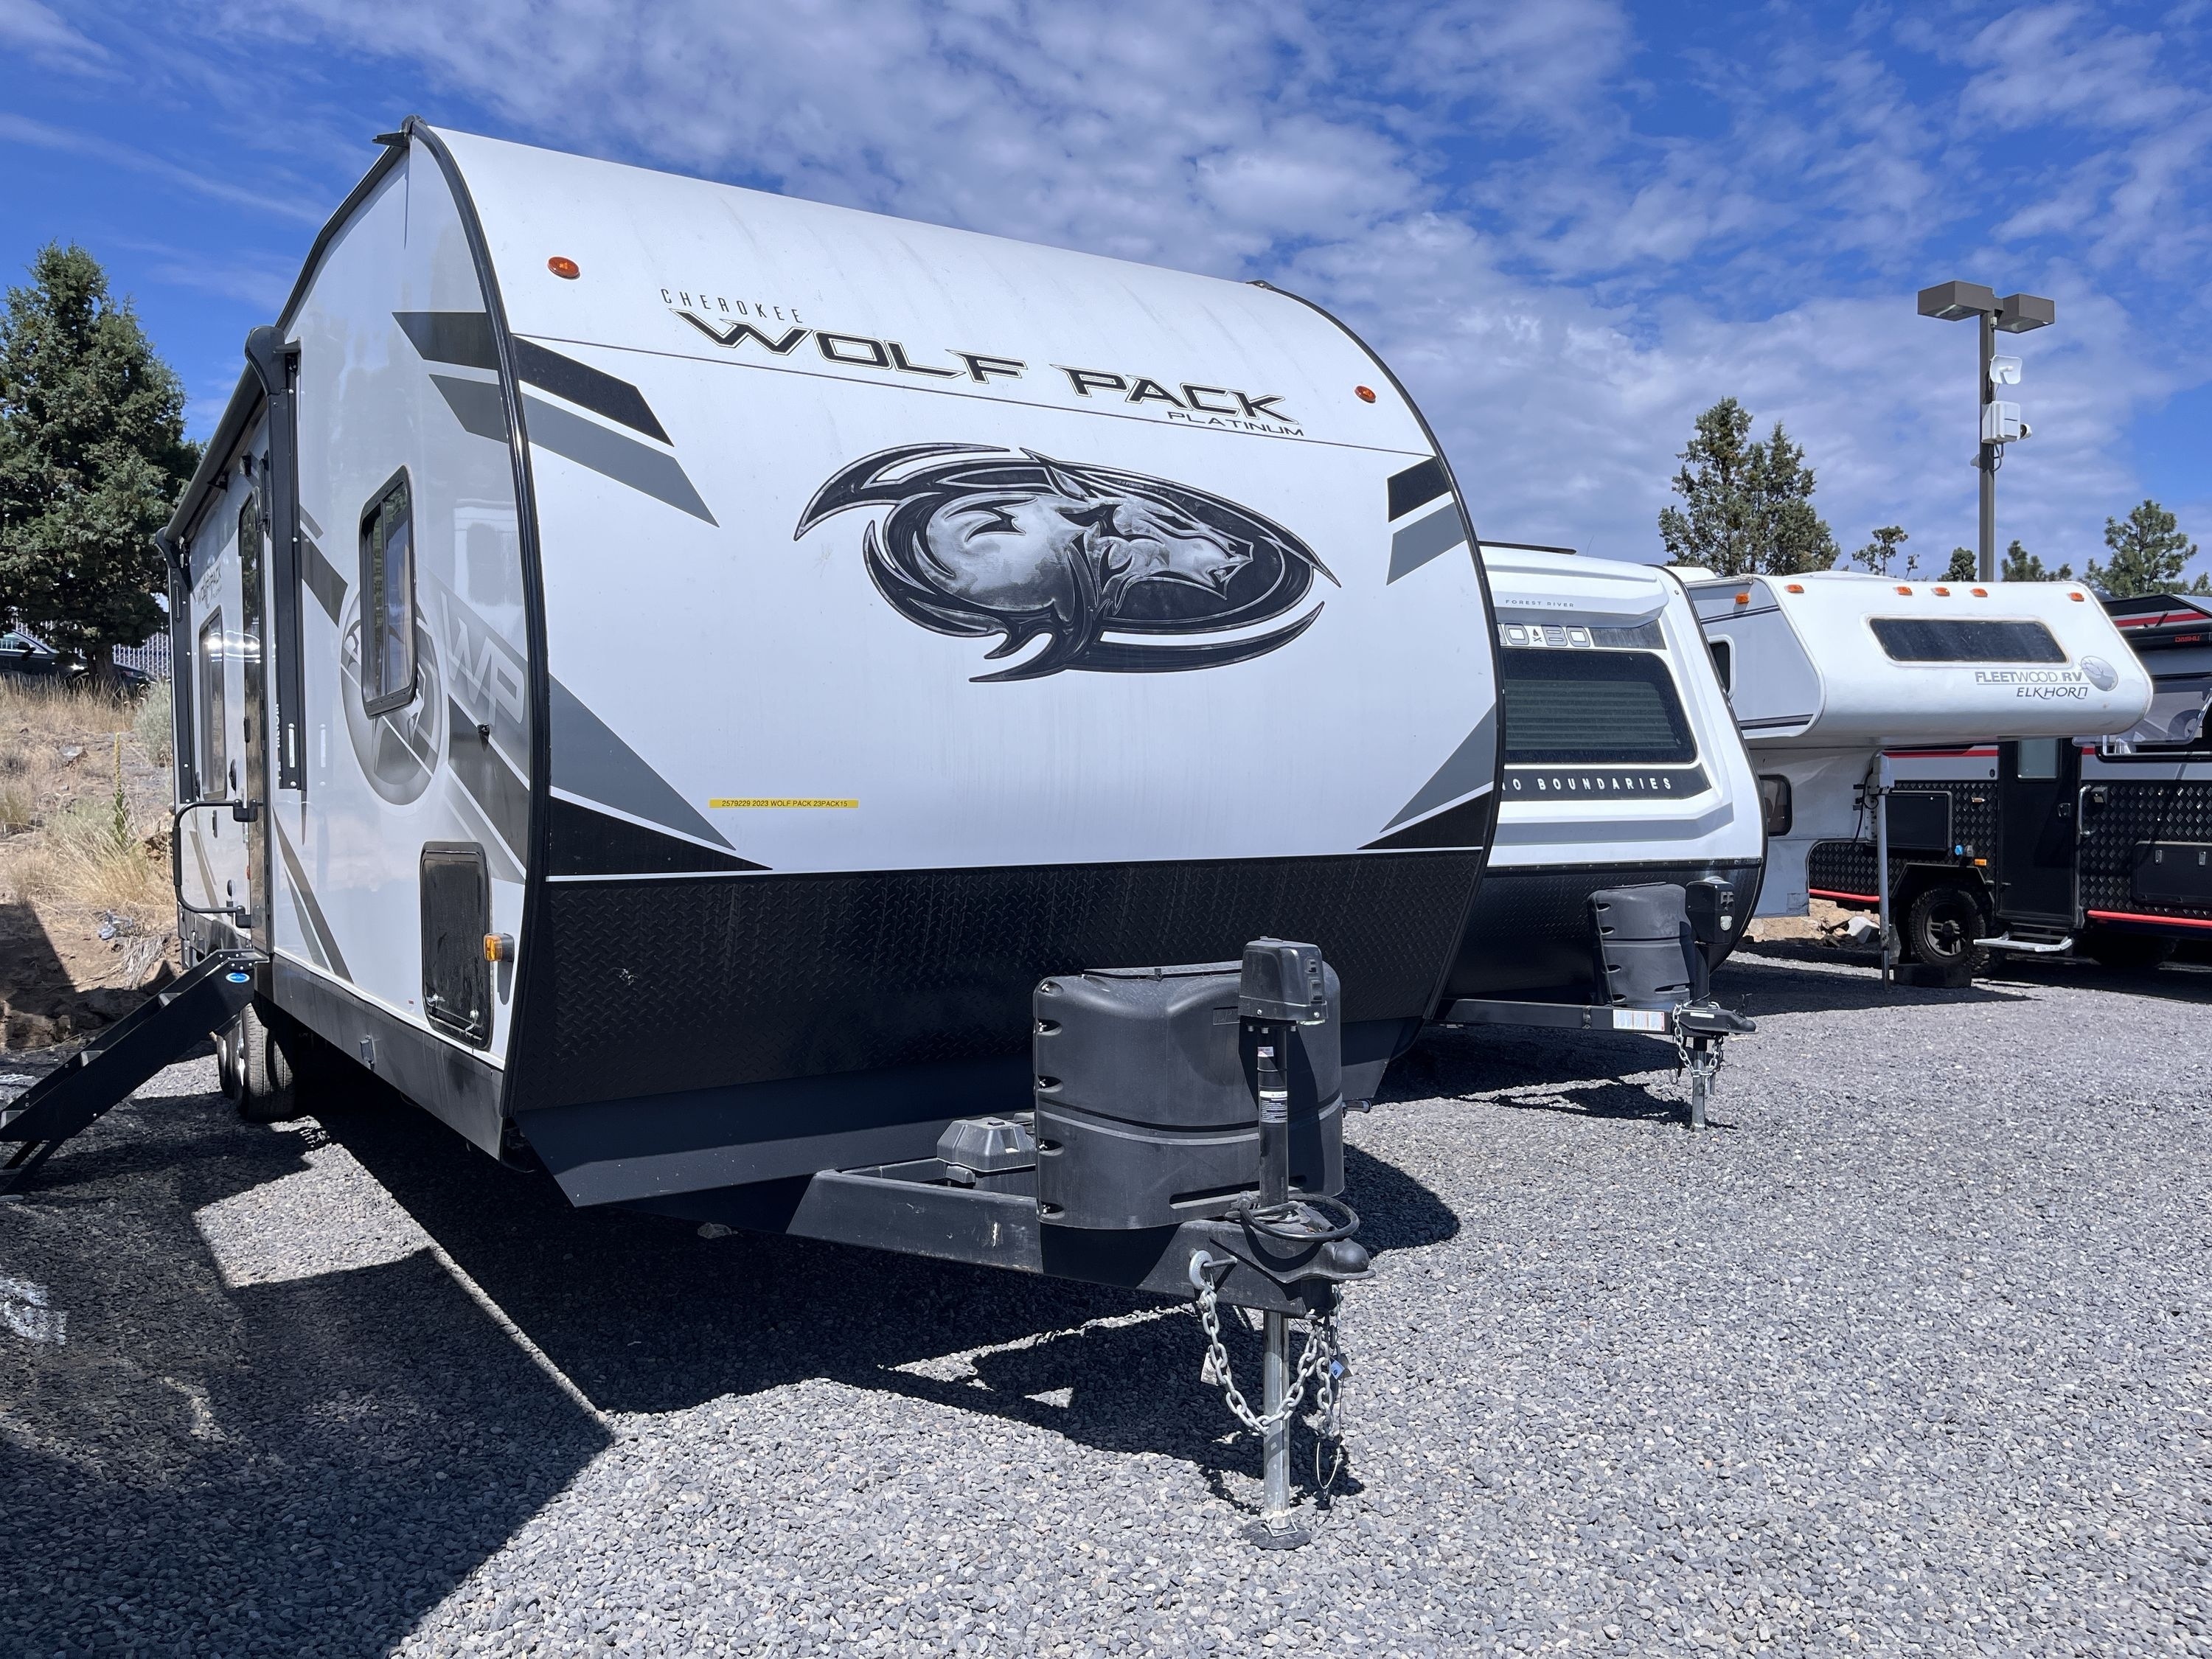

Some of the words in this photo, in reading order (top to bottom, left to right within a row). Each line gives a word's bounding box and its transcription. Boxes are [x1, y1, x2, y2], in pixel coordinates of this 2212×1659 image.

[660, 288, 803, 324] CHEROKEE
[669, 308, 1029, 384] WOLF
[1049, 364, 1299, 425] PACK
[1167, 411, 1304, 437] PLATINUM
[1537, 778, 1672, 790] BOUNDARIES
